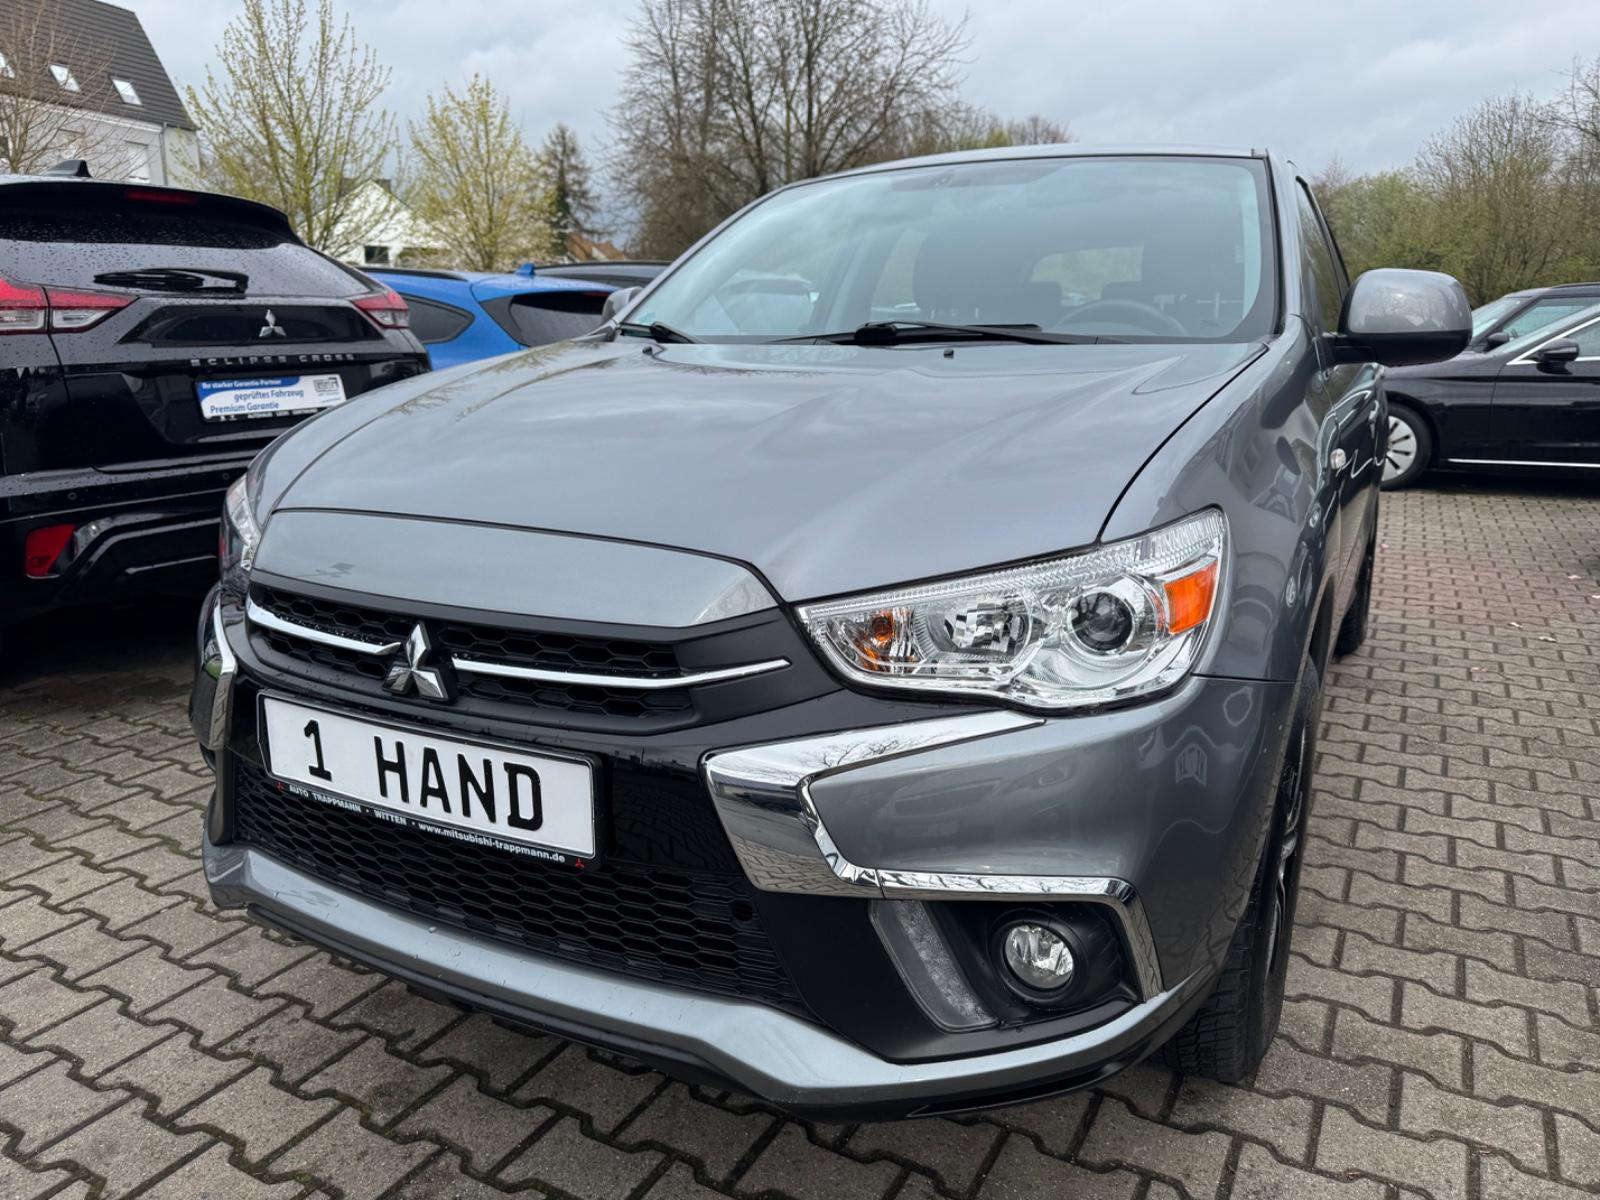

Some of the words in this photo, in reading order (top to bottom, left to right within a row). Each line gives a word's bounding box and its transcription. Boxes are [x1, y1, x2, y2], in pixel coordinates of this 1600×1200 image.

[190, 355, 287, 367] ECLIPSE
[298, 353, 354, 363] CROSS
[234, 390, 270, 403] geprüftes
[270, 389, 304, 399] Fahrzeug
[209, 403, 246, 413] Premium
[246, 401, 280, 411] Garantie
[303, 719, 332, 782] 1
[373, 735, 544, 832] HAND
[289, 784, 309, 798] AUTO
[311, 792, 362, 813] TRAPPMANN
[373, 809, 408, 826] WITTEN
[418, 822, 566, 863] www.mitsubishi-trappmann.de
